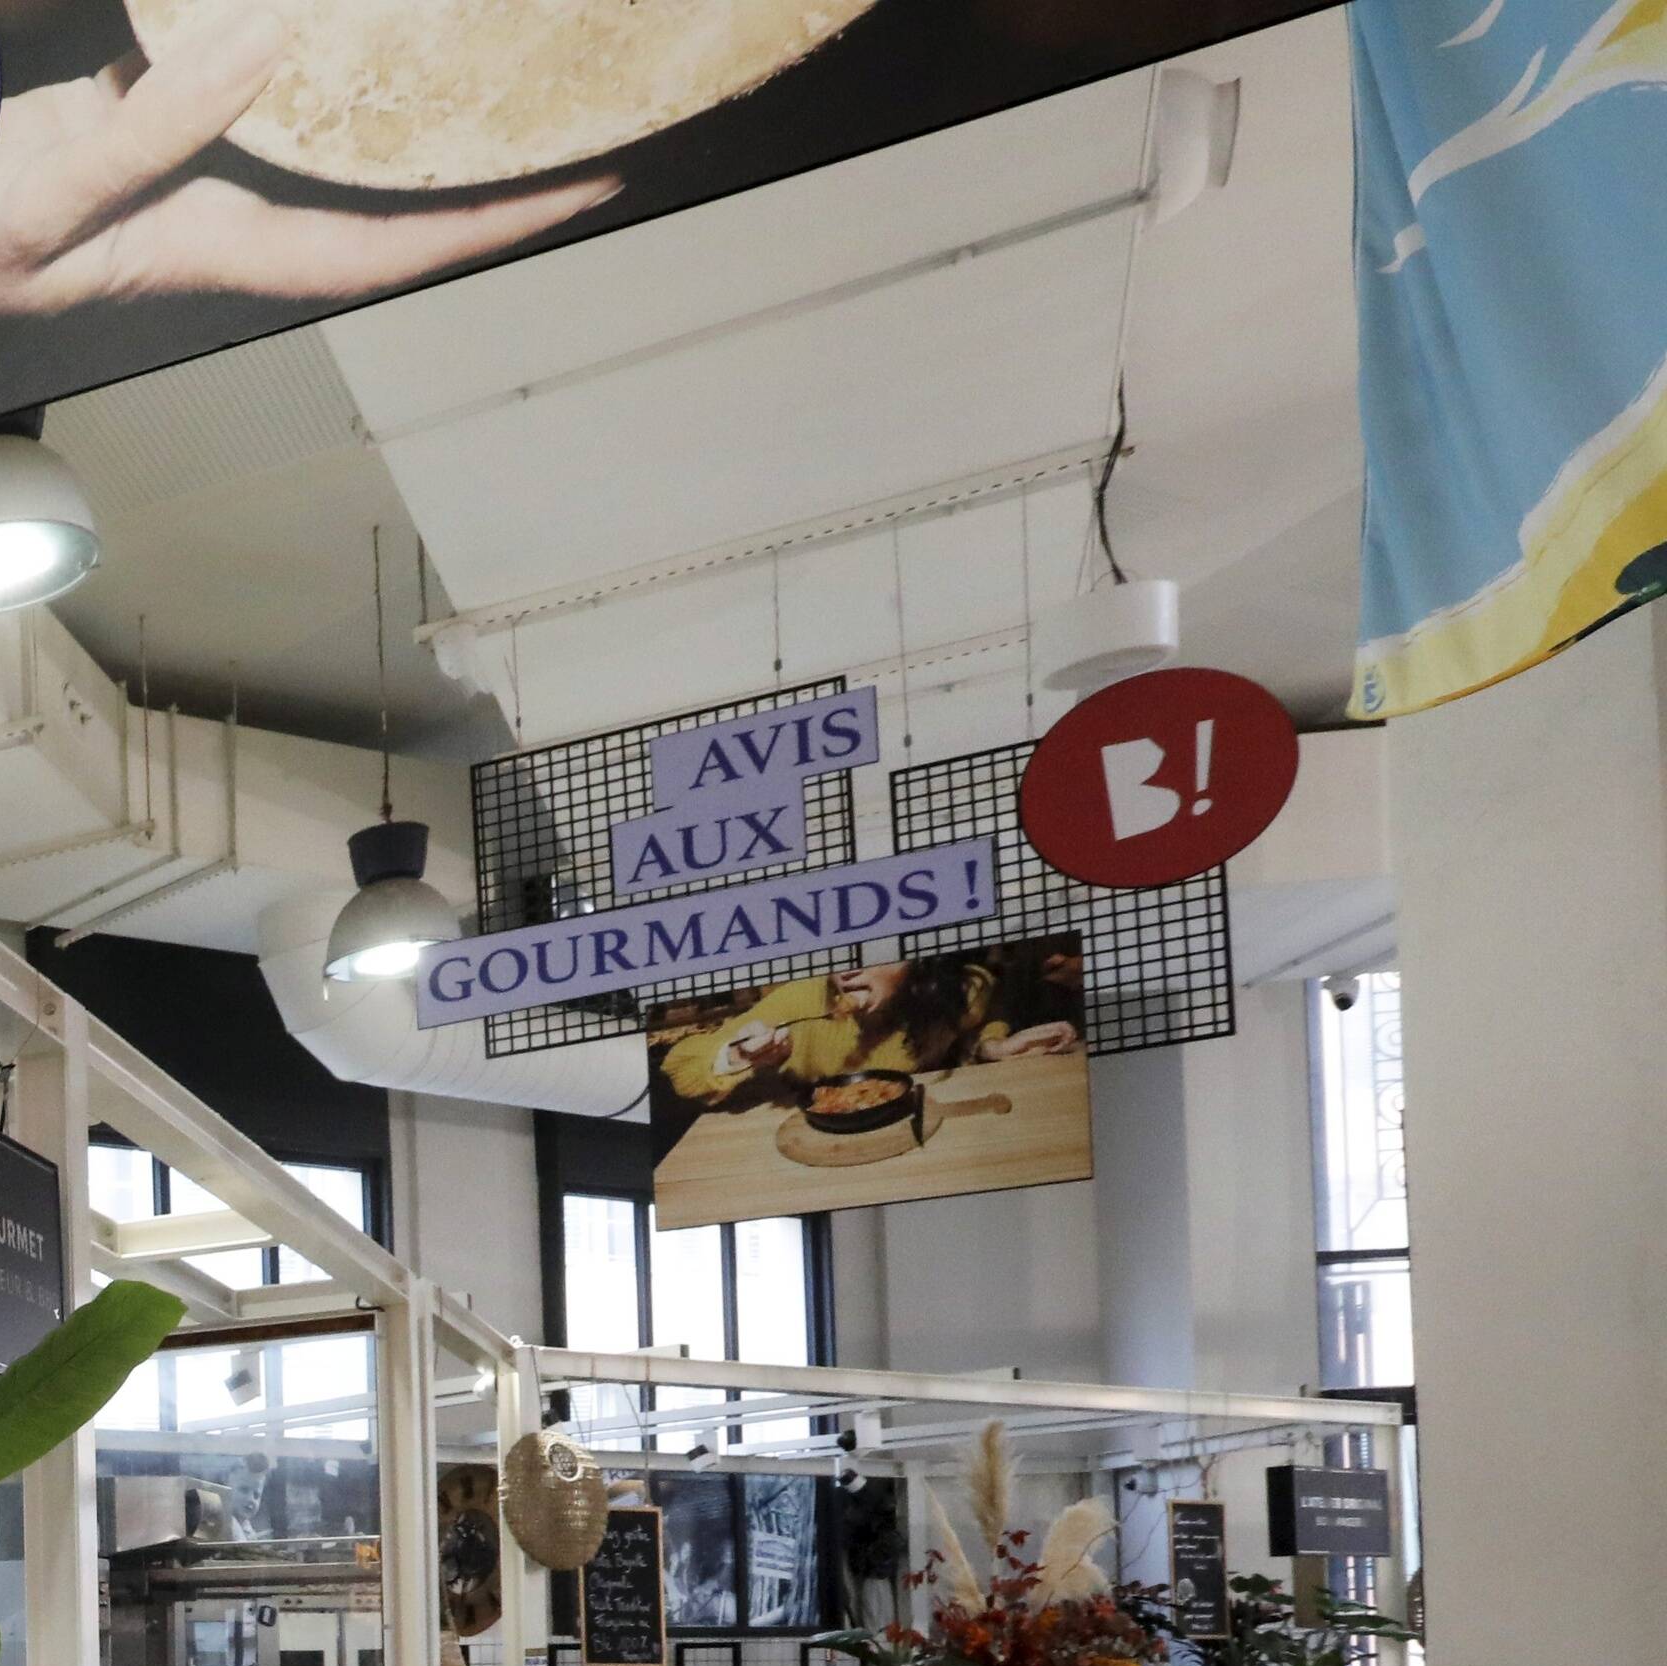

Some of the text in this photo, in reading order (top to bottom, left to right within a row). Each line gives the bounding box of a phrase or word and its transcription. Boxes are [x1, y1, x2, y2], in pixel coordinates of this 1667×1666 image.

[688, 707, 863, 792] AVIS
[1100, 718, 1215, 842] B!
[626, 803, 793, 885] AUX
[428, 868, 939, 1004] GOURMANDS
